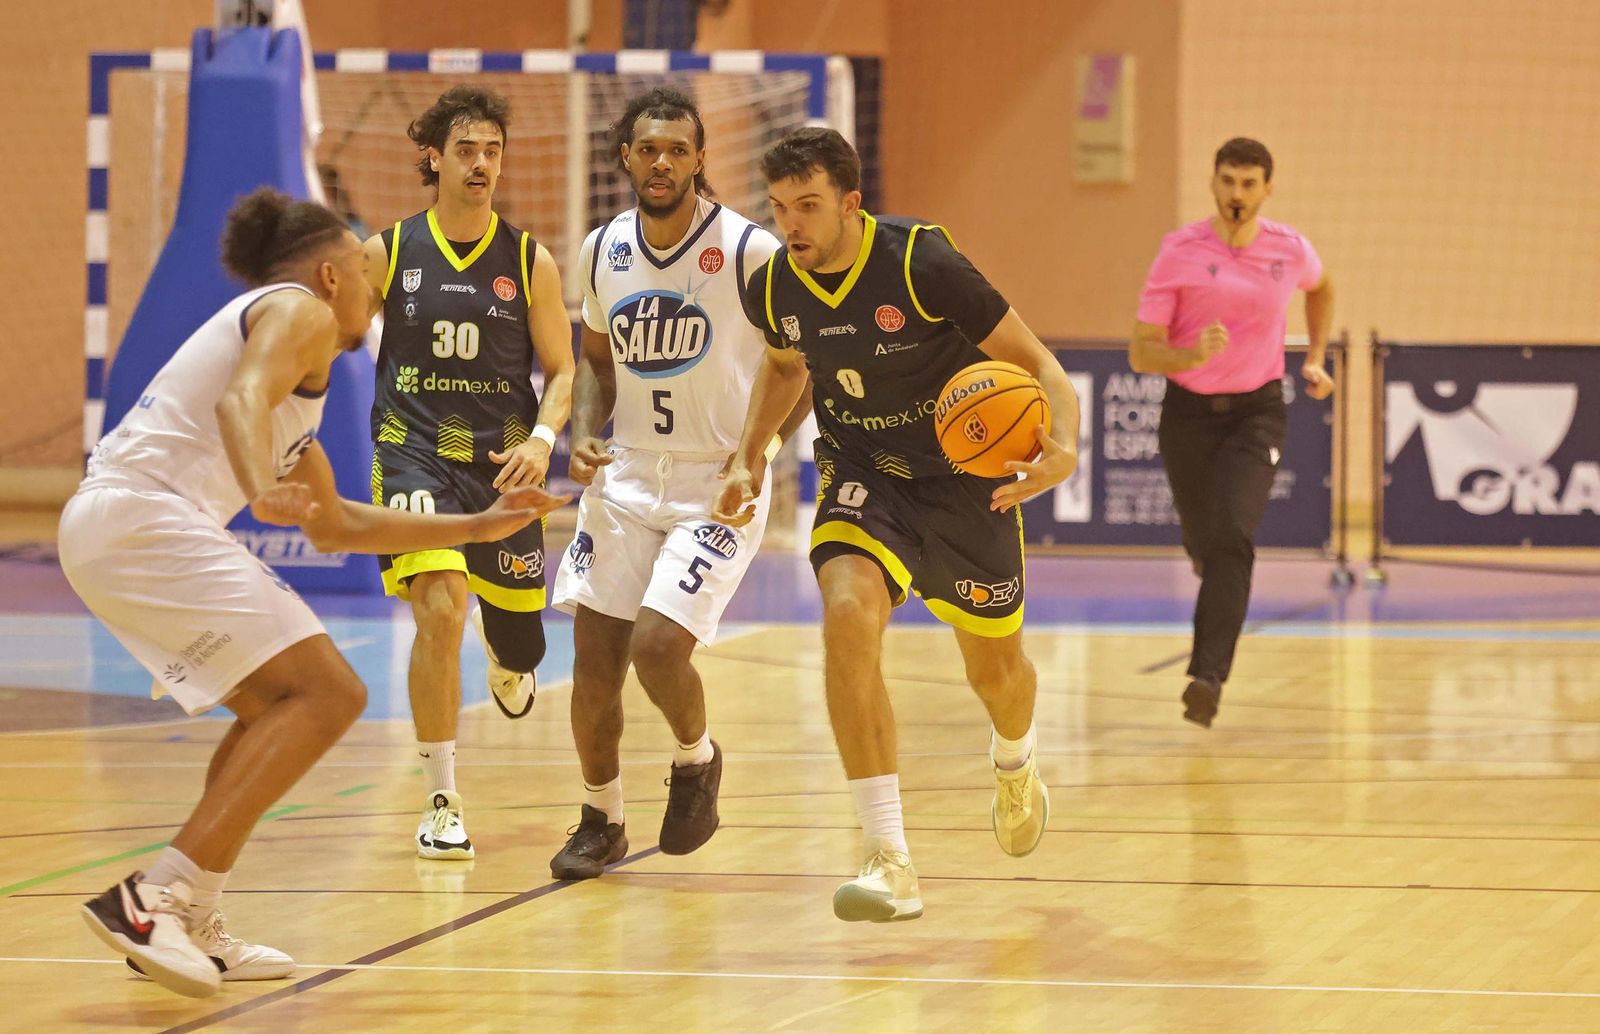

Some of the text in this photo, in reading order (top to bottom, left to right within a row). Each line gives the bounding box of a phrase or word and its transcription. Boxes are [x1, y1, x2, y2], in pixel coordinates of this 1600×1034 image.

[635, 295, 661, 319] LA
[432, 320, 480, 360] 30
[611, 314, 707, 365] SALUD
[423, 372, 510, 394] damex.io
[652, 389, 674, 435] 5
[838, 400, 937, 432] amex.io
[936, 378, 996, 425] Wilson
[692, 527, 738, 559] SALUD
[713, 526, 727, 539] LA
[678, 556, 713, 595] 5
